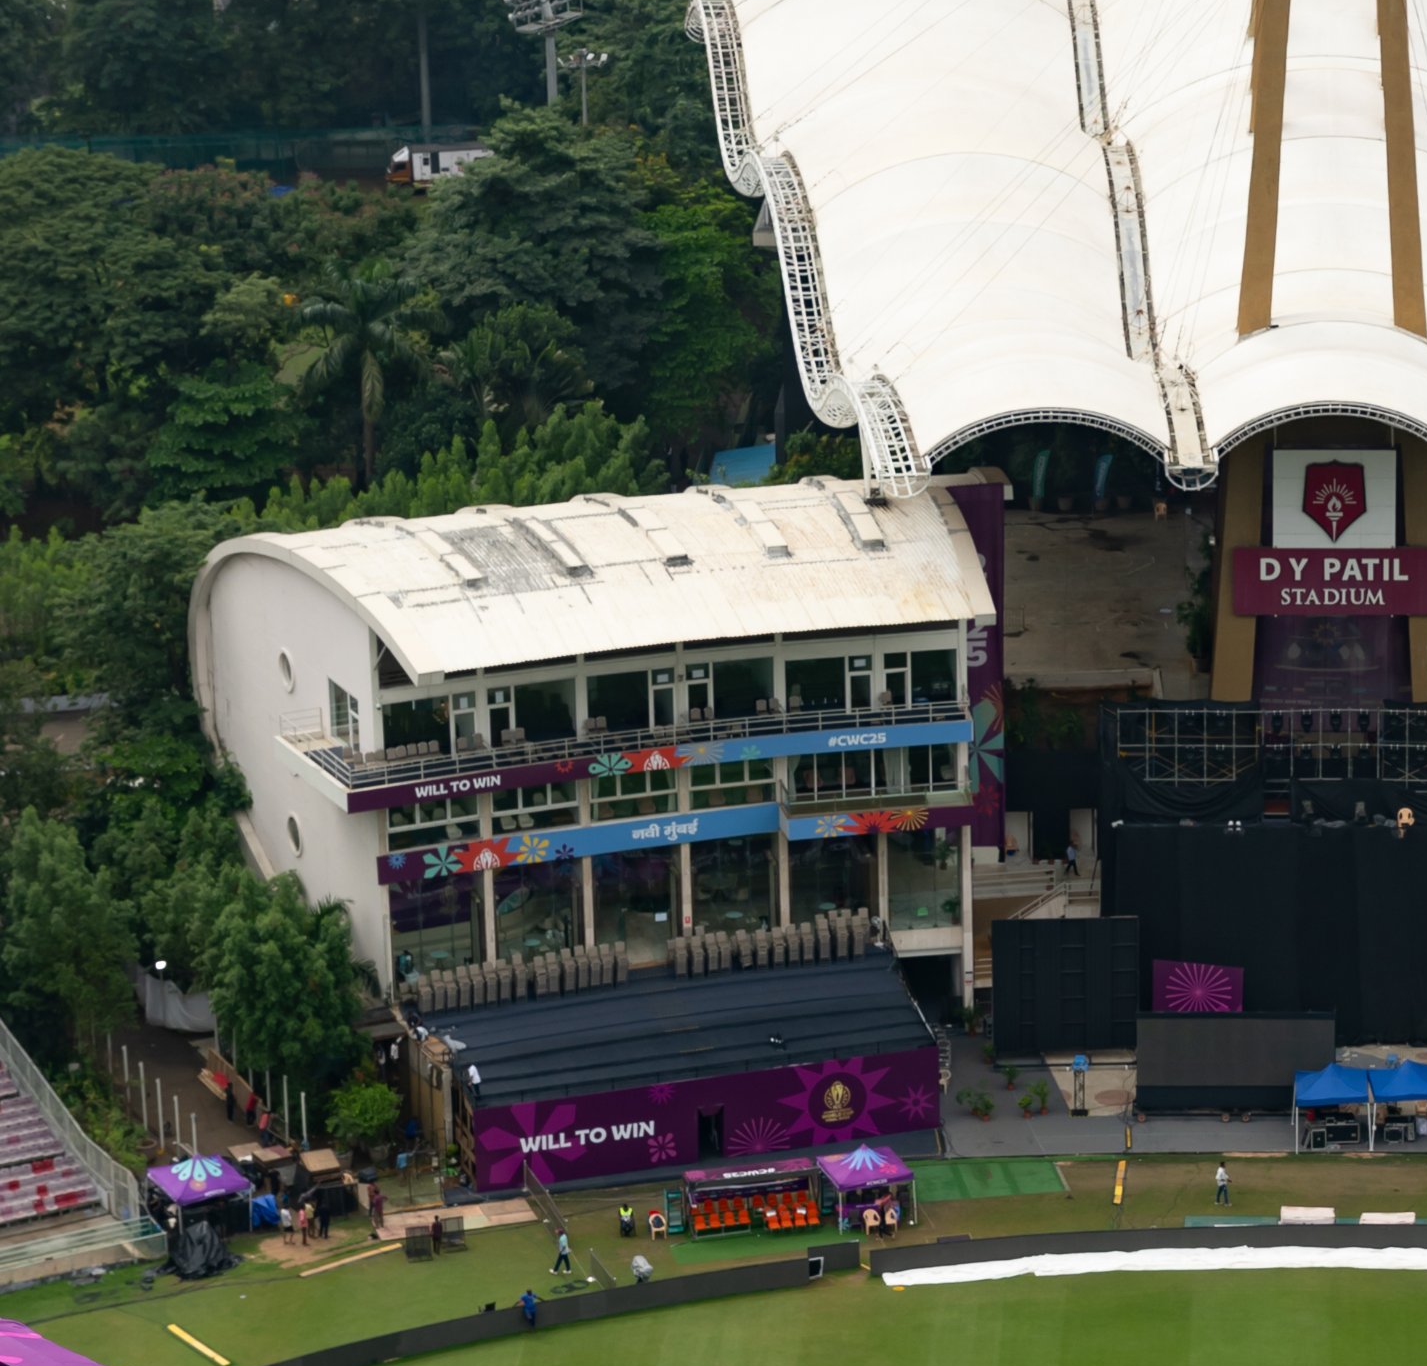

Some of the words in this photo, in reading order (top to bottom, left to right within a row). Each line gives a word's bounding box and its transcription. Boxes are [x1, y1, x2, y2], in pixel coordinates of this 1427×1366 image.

[1259, 557, 1281, 581] D
[1288, 557, 1309, 581] Y
[1323, 557, 1409, 581] PATIL
[1281, 588, 1386, 605] STADIUM
[828, 732, 887, 747] #CWC25
[415, 782, 448, 798] WILL
[450, 779, 471, 792] TO
[473, 774, 501, 789] WIN
[632, 823, 660, 840] नवी
[664, 818, 699, 841] मुंबई
[519, 1132, 572, 1153] WILL
[575, 1127, 607, 1146] TO
[611, 1120, 655, 1141] WIN
